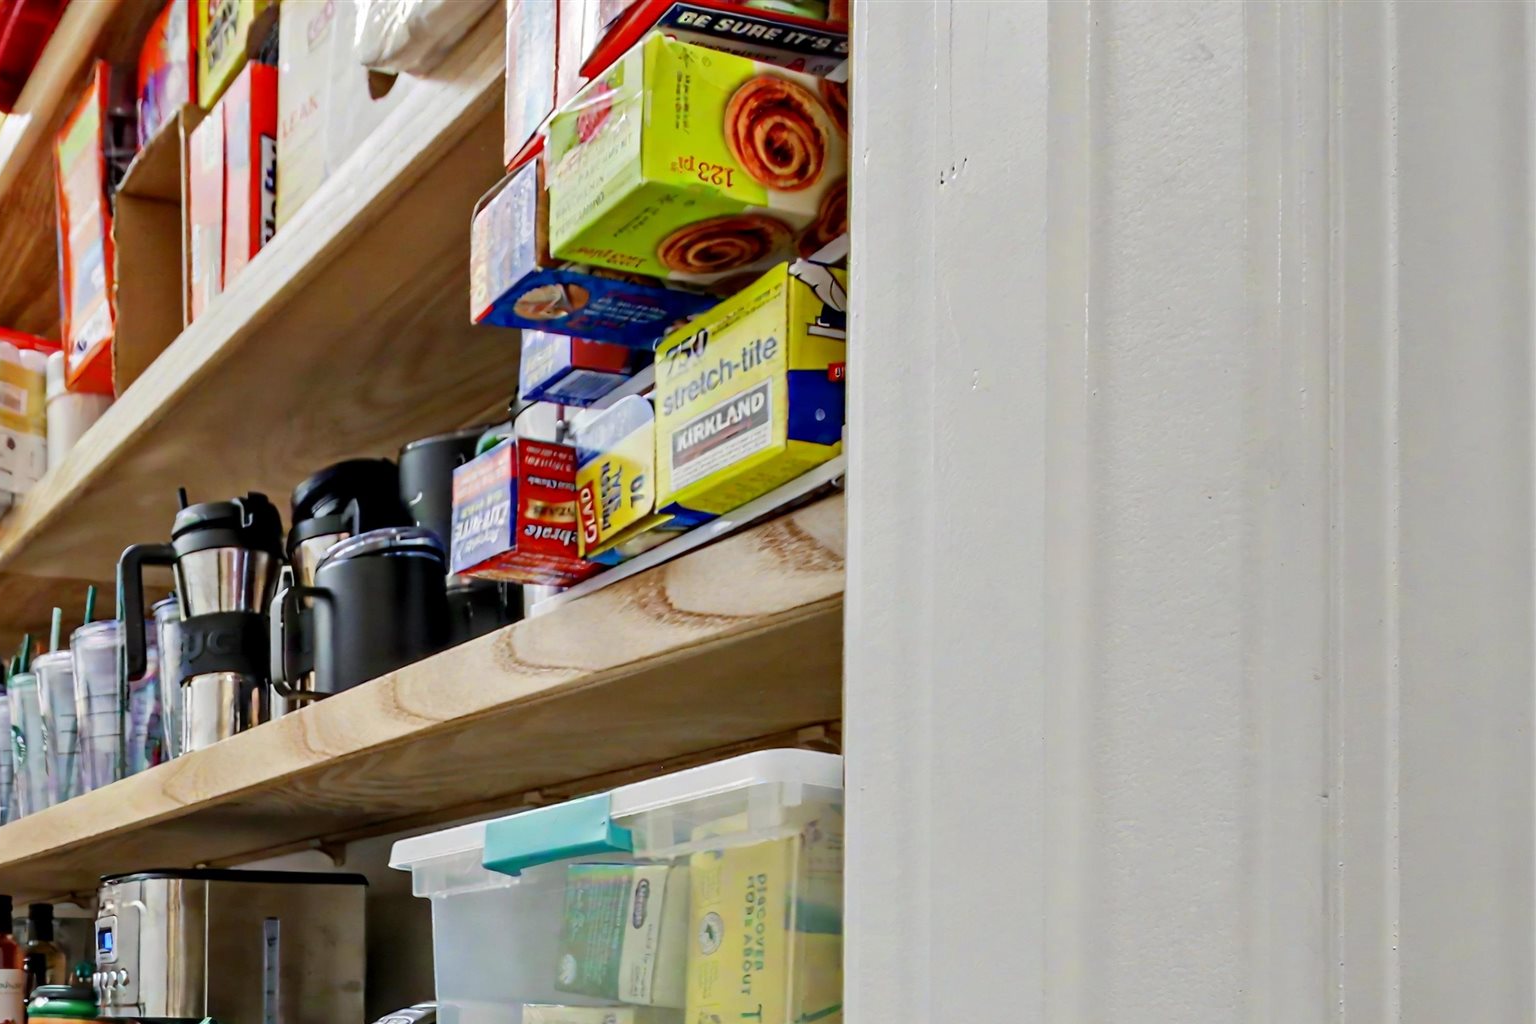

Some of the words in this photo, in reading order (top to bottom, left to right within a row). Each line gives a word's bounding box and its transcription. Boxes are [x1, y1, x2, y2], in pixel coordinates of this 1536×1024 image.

[677, 11, 712, 28] BE
[713, 18, 783, 41] SURE
[698, 161, 735, 188] 123
[663, 335, 778, 417] stretch-tite
[676, 391, 764, 453] KIRKLAND
[581, 487, 598, 543] GLAD
[755, 873, 768, 971] DISCOVER
[741, 934, 754, 995] ABOUT
